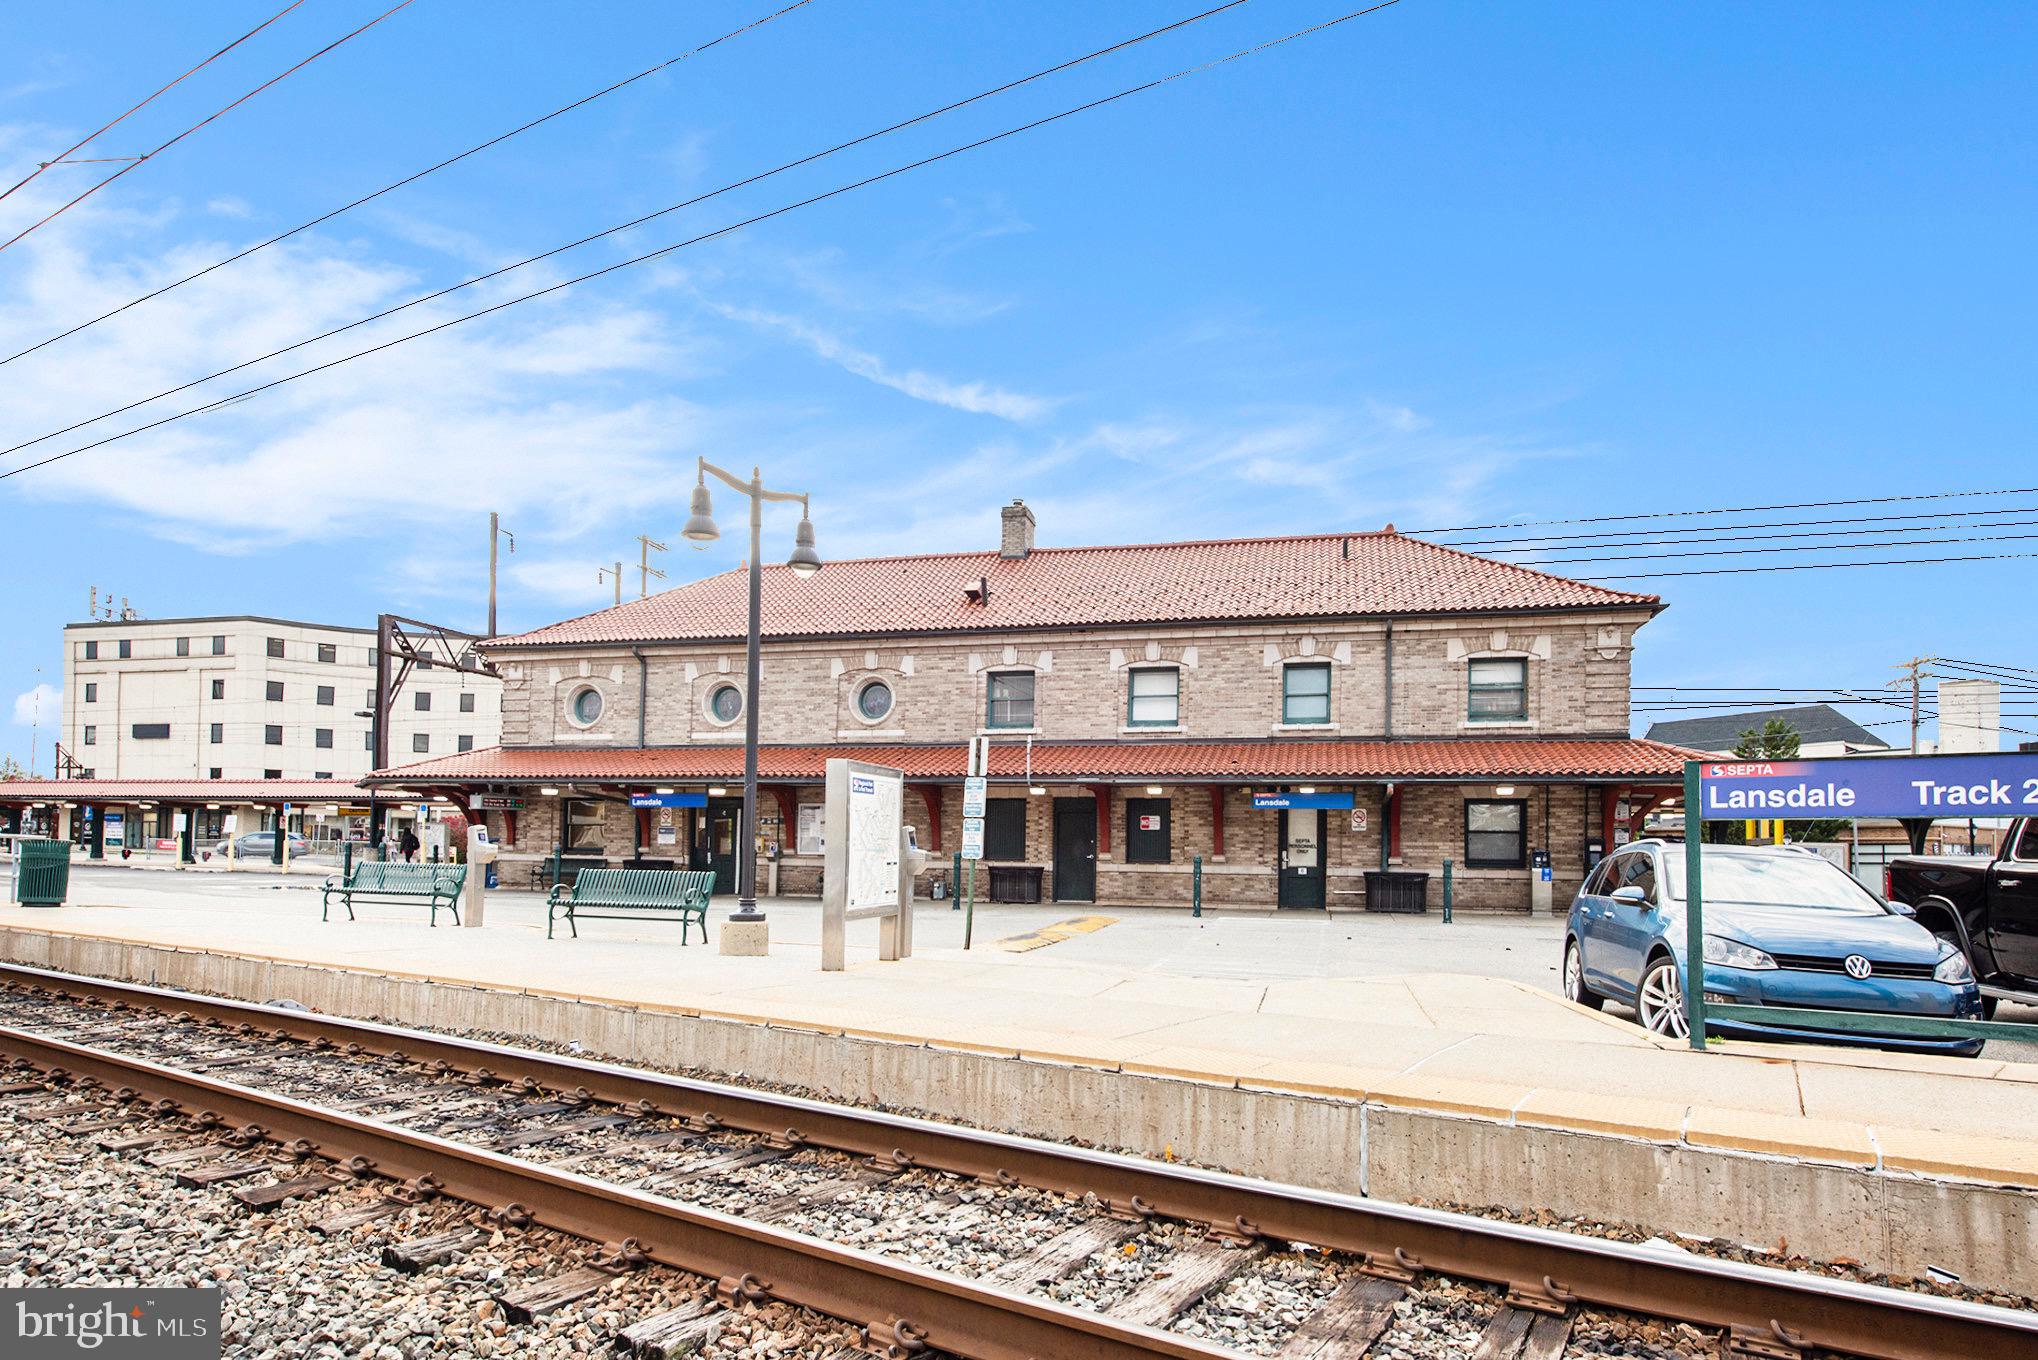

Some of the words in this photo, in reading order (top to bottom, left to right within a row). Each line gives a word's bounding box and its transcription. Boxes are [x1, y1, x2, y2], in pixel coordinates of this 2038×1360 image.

[1727, 764, 1774, 776] SEPTA
[1709, 783, 1856, 809] Lansdale
[1911, 779, 2012, 806] Track
[2022, 778, 2038, 805] 2
[631, 798, 663, 807] Lansdale
[1255, 798, 1290, 806] Lansdale
